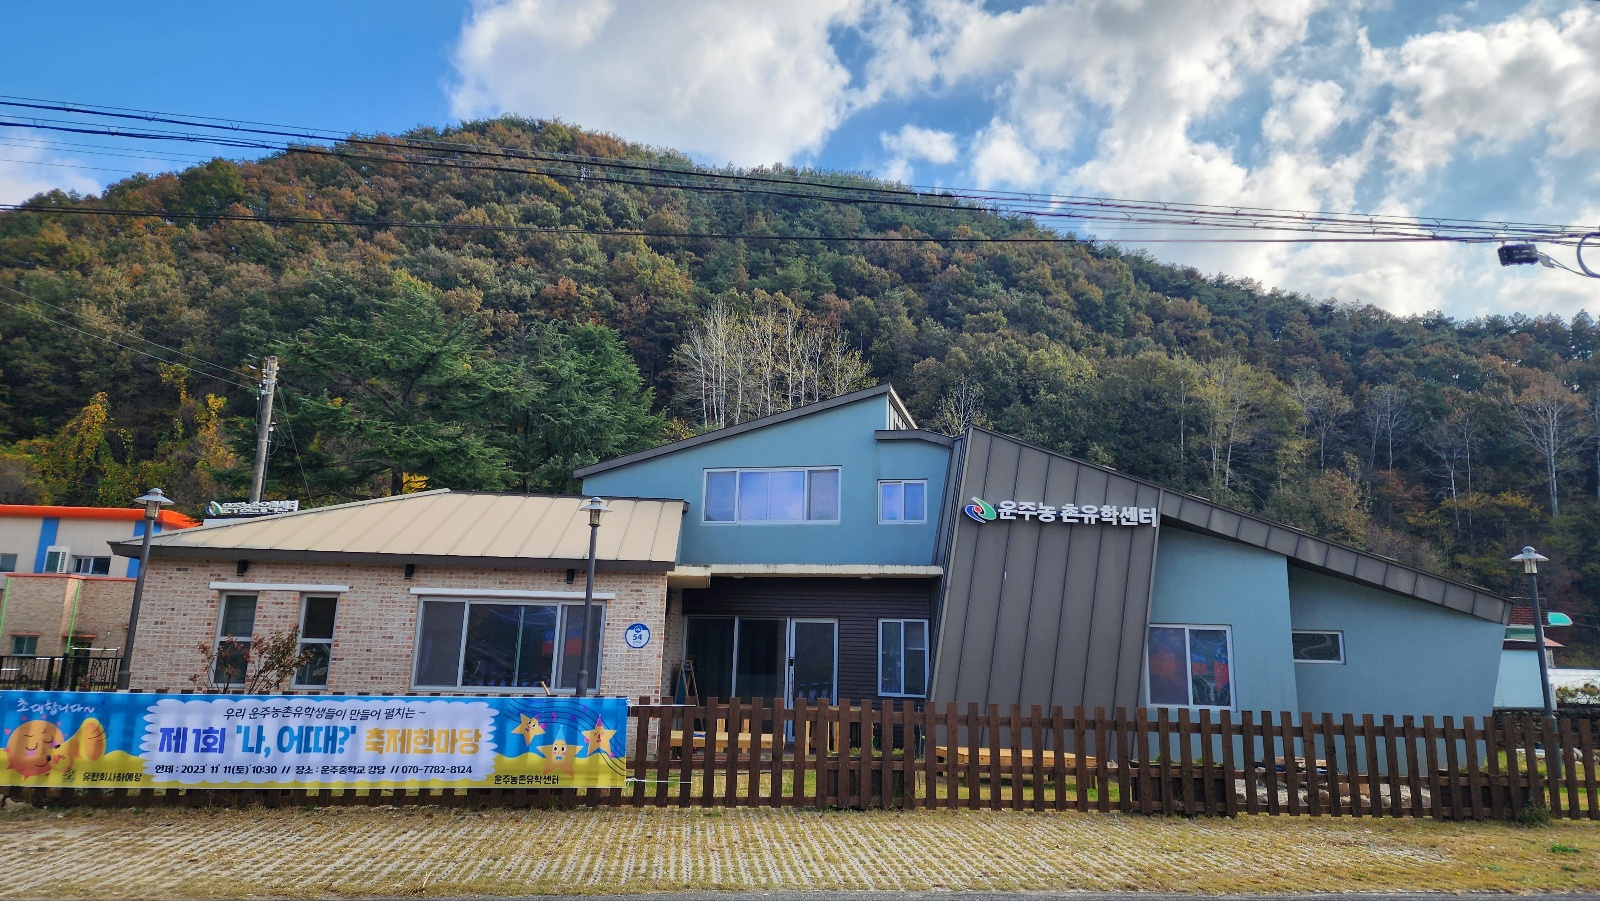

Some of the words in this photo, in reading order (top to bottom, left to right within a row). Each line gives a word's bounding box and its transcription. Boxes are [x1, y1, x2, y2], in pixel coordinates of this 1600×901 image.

[223, 707, 247, 720] 우리
[248, 705, 347, 720] 운주농촌유학생들이
[349, 708, 381, 720] 만들어
[365, 727, 482, 754] 축제한마당
[320, 765, 365, 775] 운주중학교
[368, 765, 386, 775] 강당
[401, 765, 472, 774] 070-7782-8124
[494, 775, 559, 785] 운주농촌유학센터
